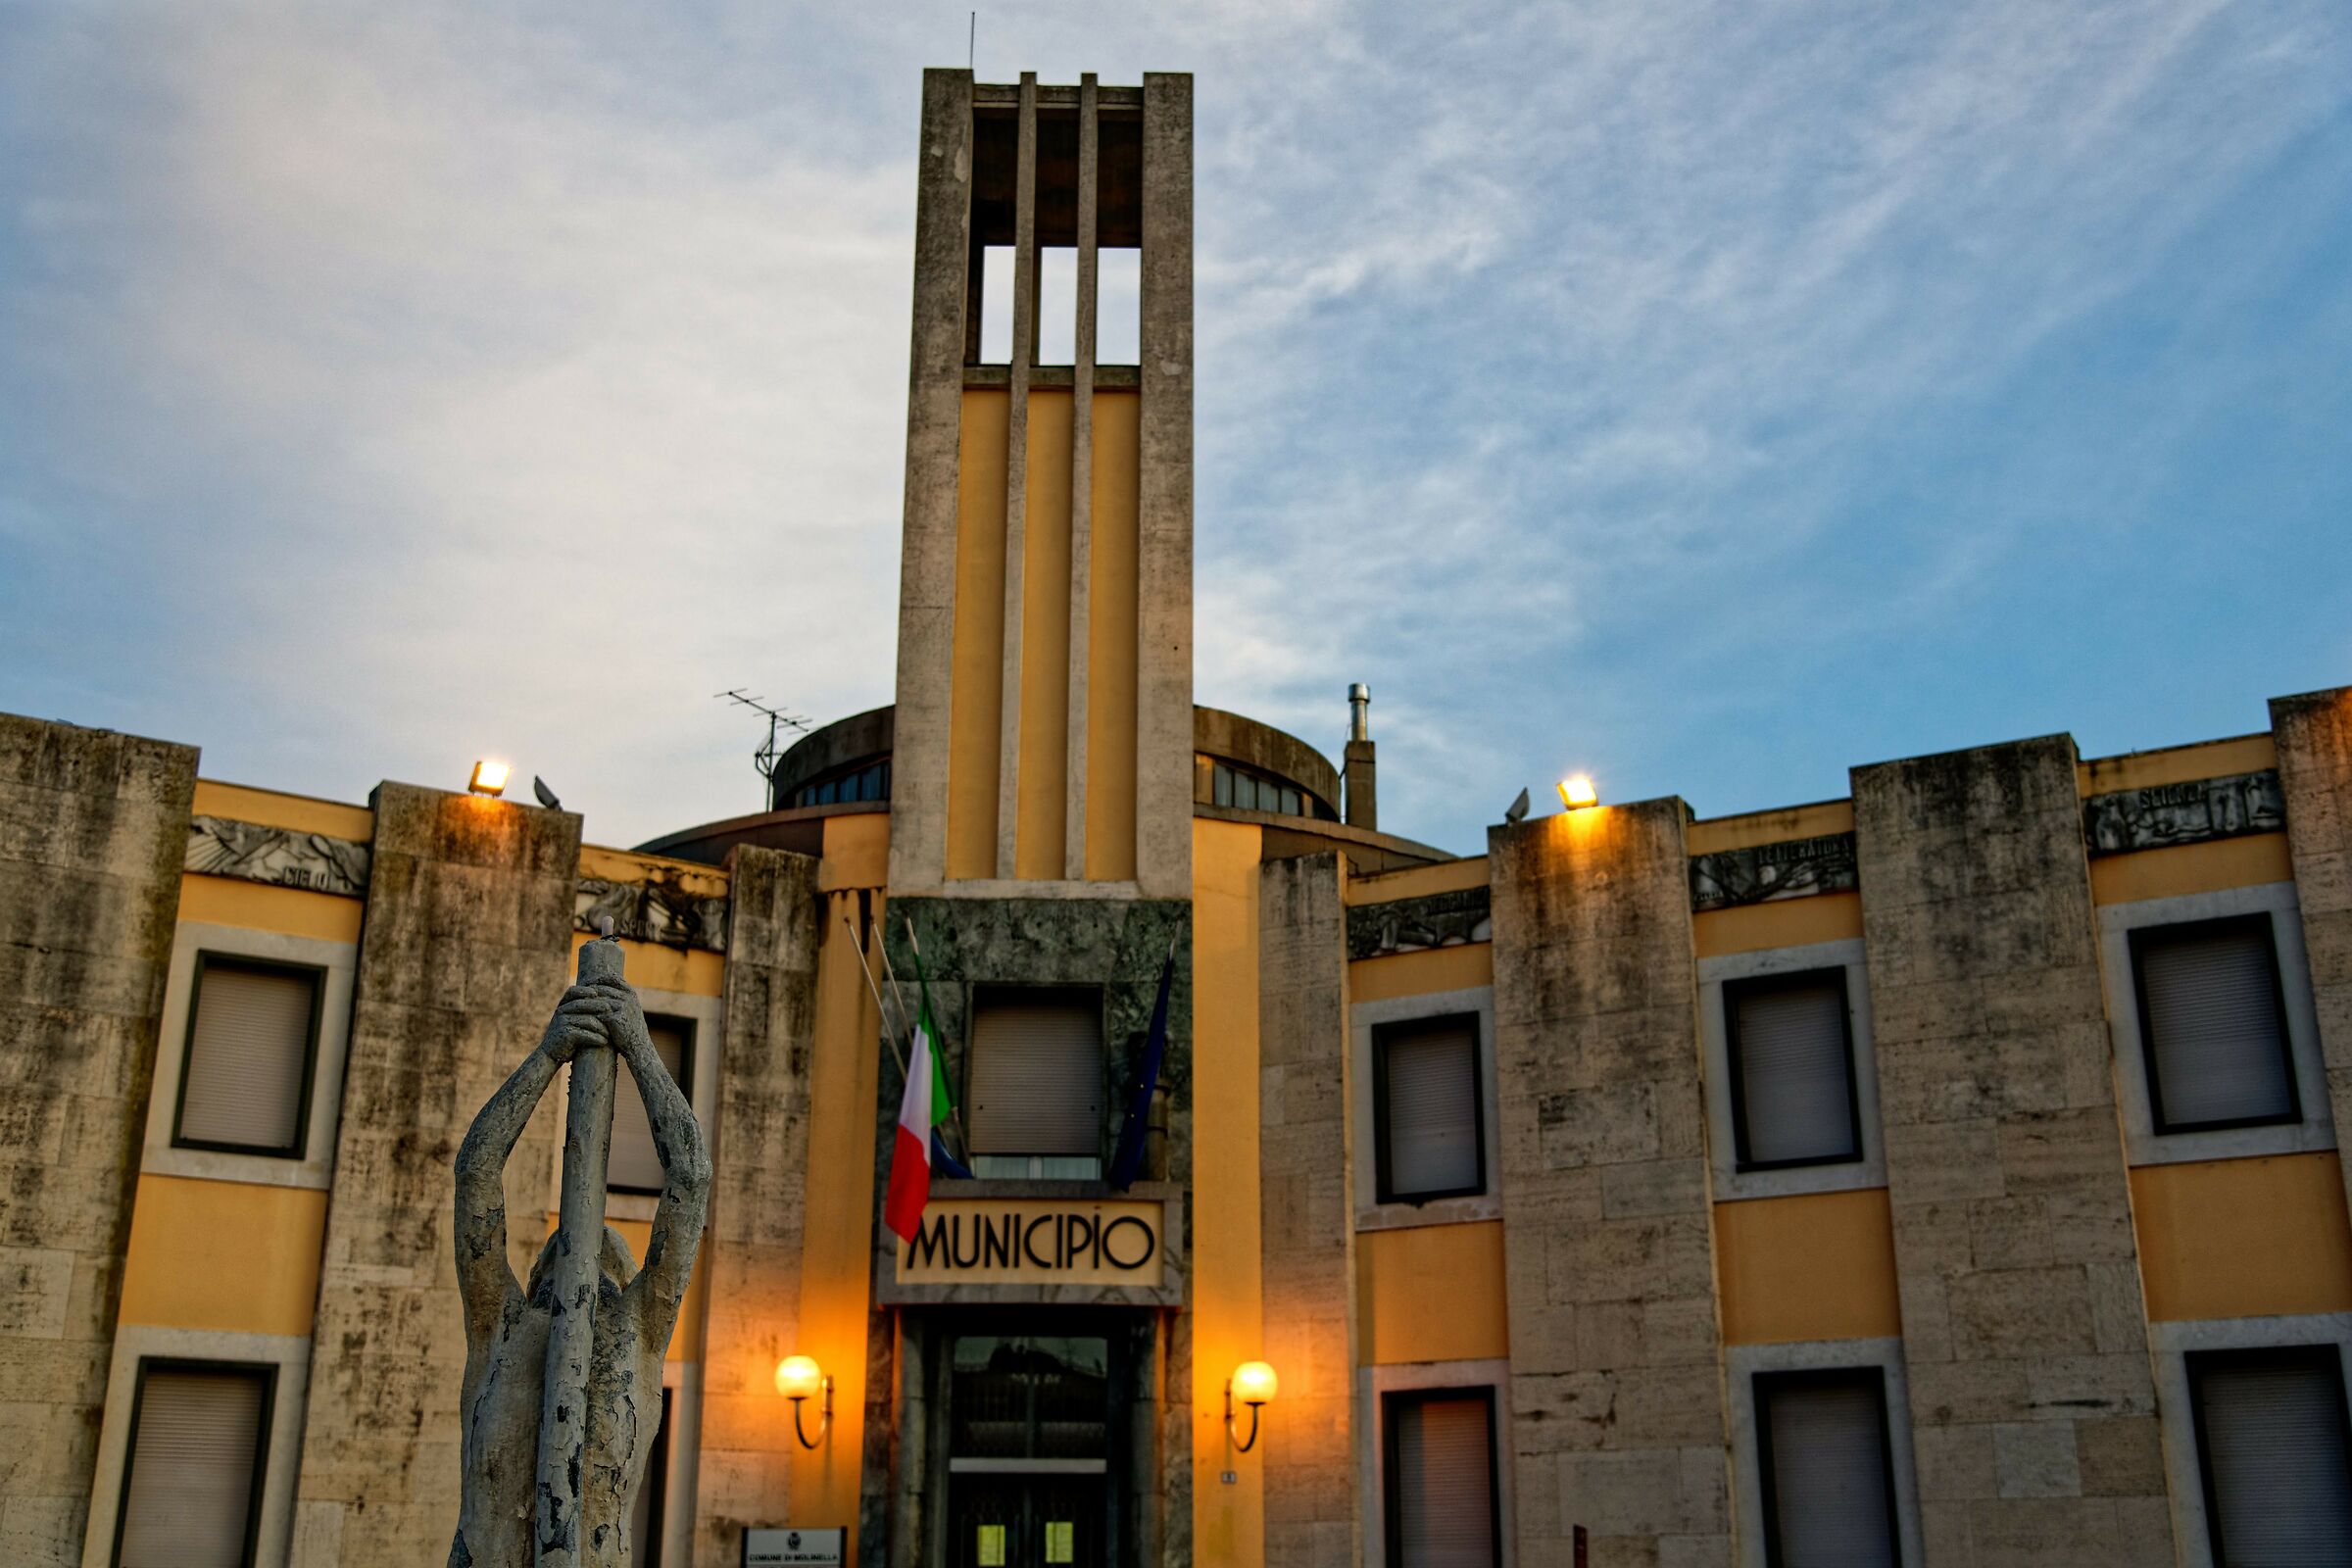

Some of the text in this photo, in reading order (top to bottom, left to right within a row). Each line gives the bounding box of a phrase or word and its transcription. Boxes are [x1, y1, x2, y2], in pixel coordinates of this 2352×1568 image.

[906, 1206, 1154, 1270] MUNICIPIO
[749, 1552, 782, 1561] COMUNE
[784, 1552, 793, 1561] DI
